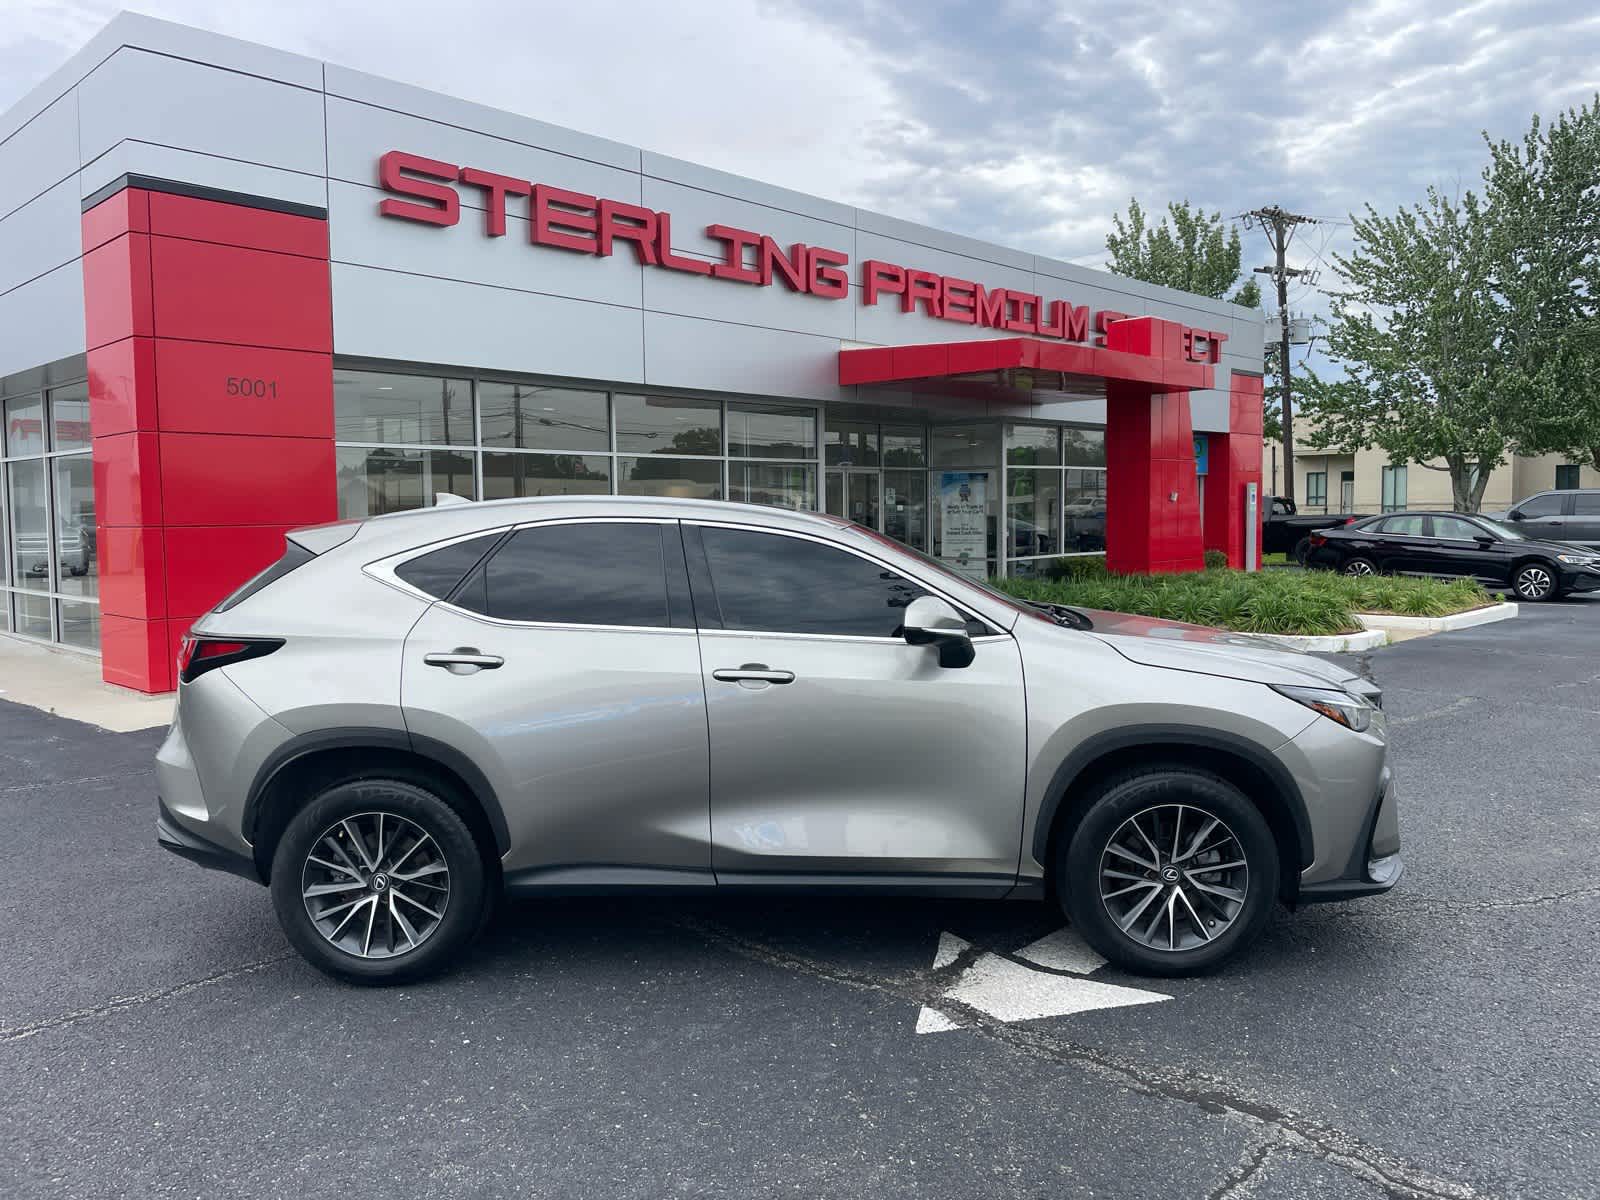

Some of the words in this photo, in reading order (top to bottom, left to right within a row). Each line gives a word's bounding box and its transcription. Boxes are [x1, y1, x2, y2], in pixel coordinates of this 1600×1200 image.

[379, 150, 849, 299] STERLING
[863, 260, 1089, 342] PREMIUM
[226, 376, 278, 399] 5001
